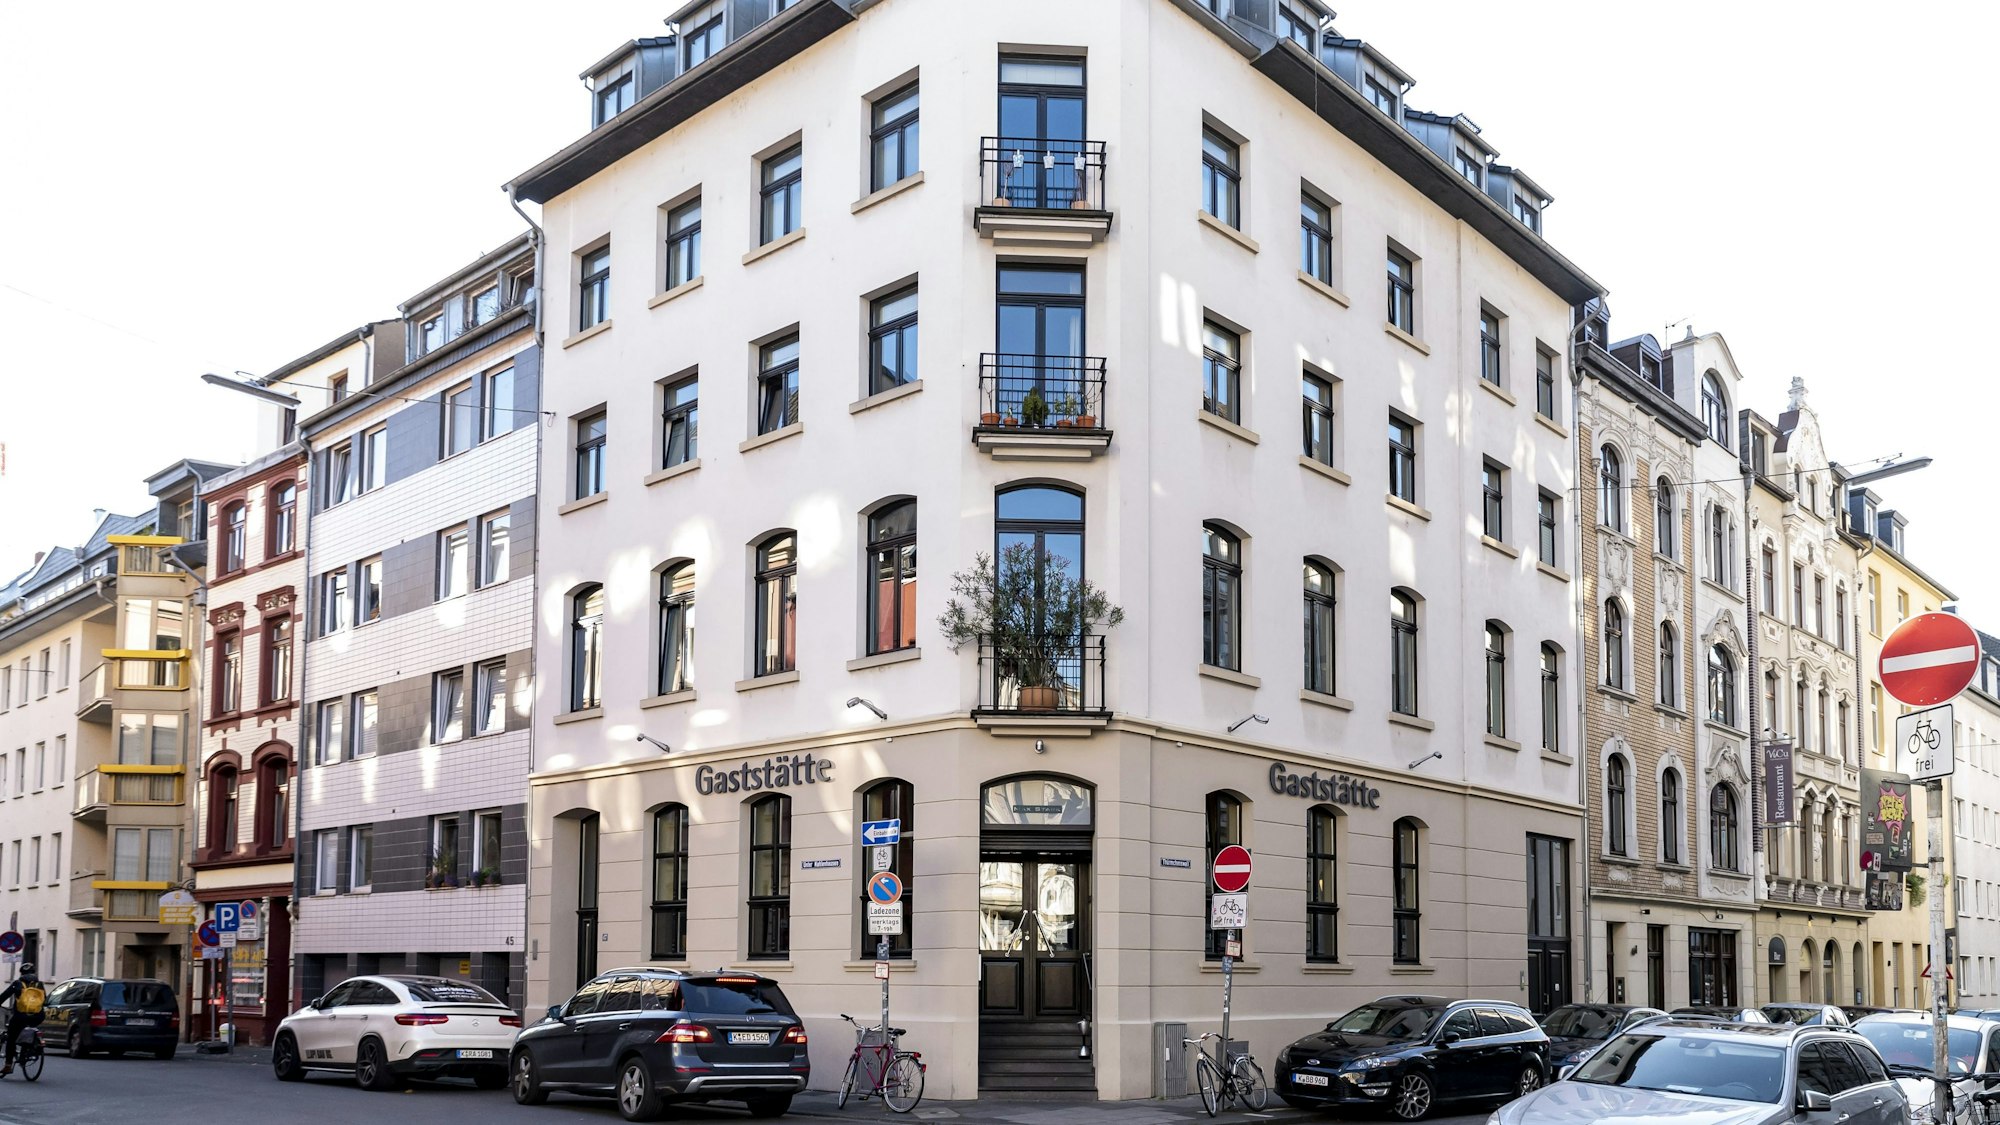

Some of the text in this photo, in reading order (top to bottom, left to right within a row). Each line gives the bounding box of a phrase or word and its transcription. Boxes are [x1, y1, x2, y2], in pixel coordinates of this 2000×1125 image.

[695, 753, 833, 795] Gaststätte
[1916, 755, 1934, 772] frei
[1269, 762, 1380, 809] Gaststätte
[1775, 764, 1785, 818] Restaurant
[221, 907, 235, 929] P
[1223, 916, 1236, 924] frei
[505, 936, 514, 945] 45
